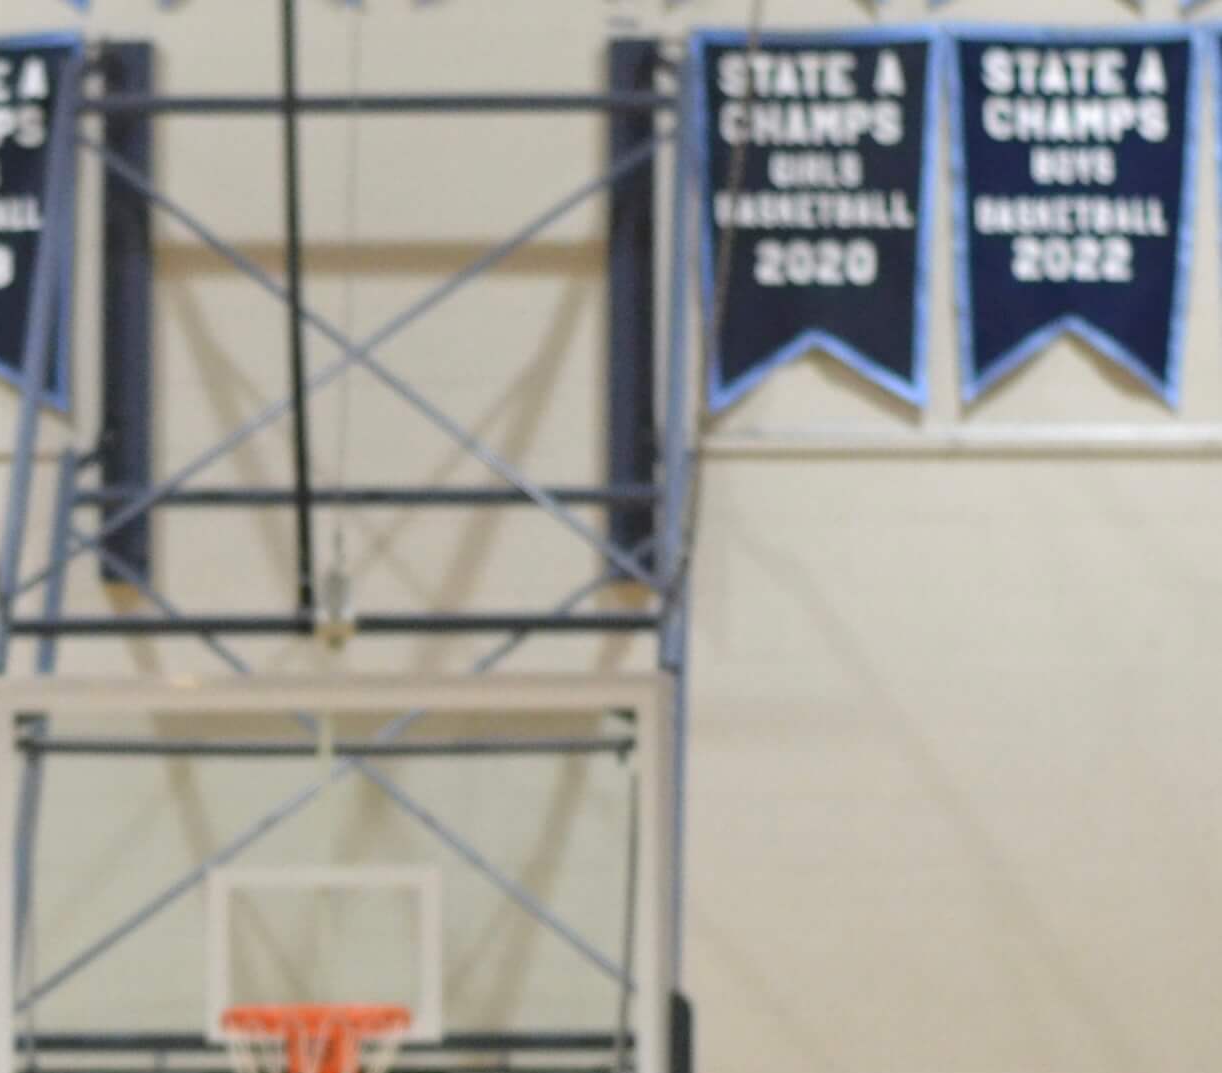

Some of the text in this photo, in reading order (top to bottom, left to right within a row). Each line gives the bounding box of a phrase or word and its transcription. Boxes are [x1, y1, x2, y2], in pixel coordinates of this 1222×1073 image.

[17, 58, 48, 100] A
[719, 49, 905, 97] STATE A
[982, 48, 1166, 96] STATE A
[720, 99, 903, 146] CHAMPS
[982, 95, 1168, 142] CHAMPS
[768, 151, 863, 189] GIRLS
[1030, 146, 1116, 185] BOYS
[714, 191, 915, 229] BASKETBALL
[974, 196, 1167, 236] BASKETBALL
[754, 239, 878, 286] 2020
[1011, 237, 1133, 282] 2022
